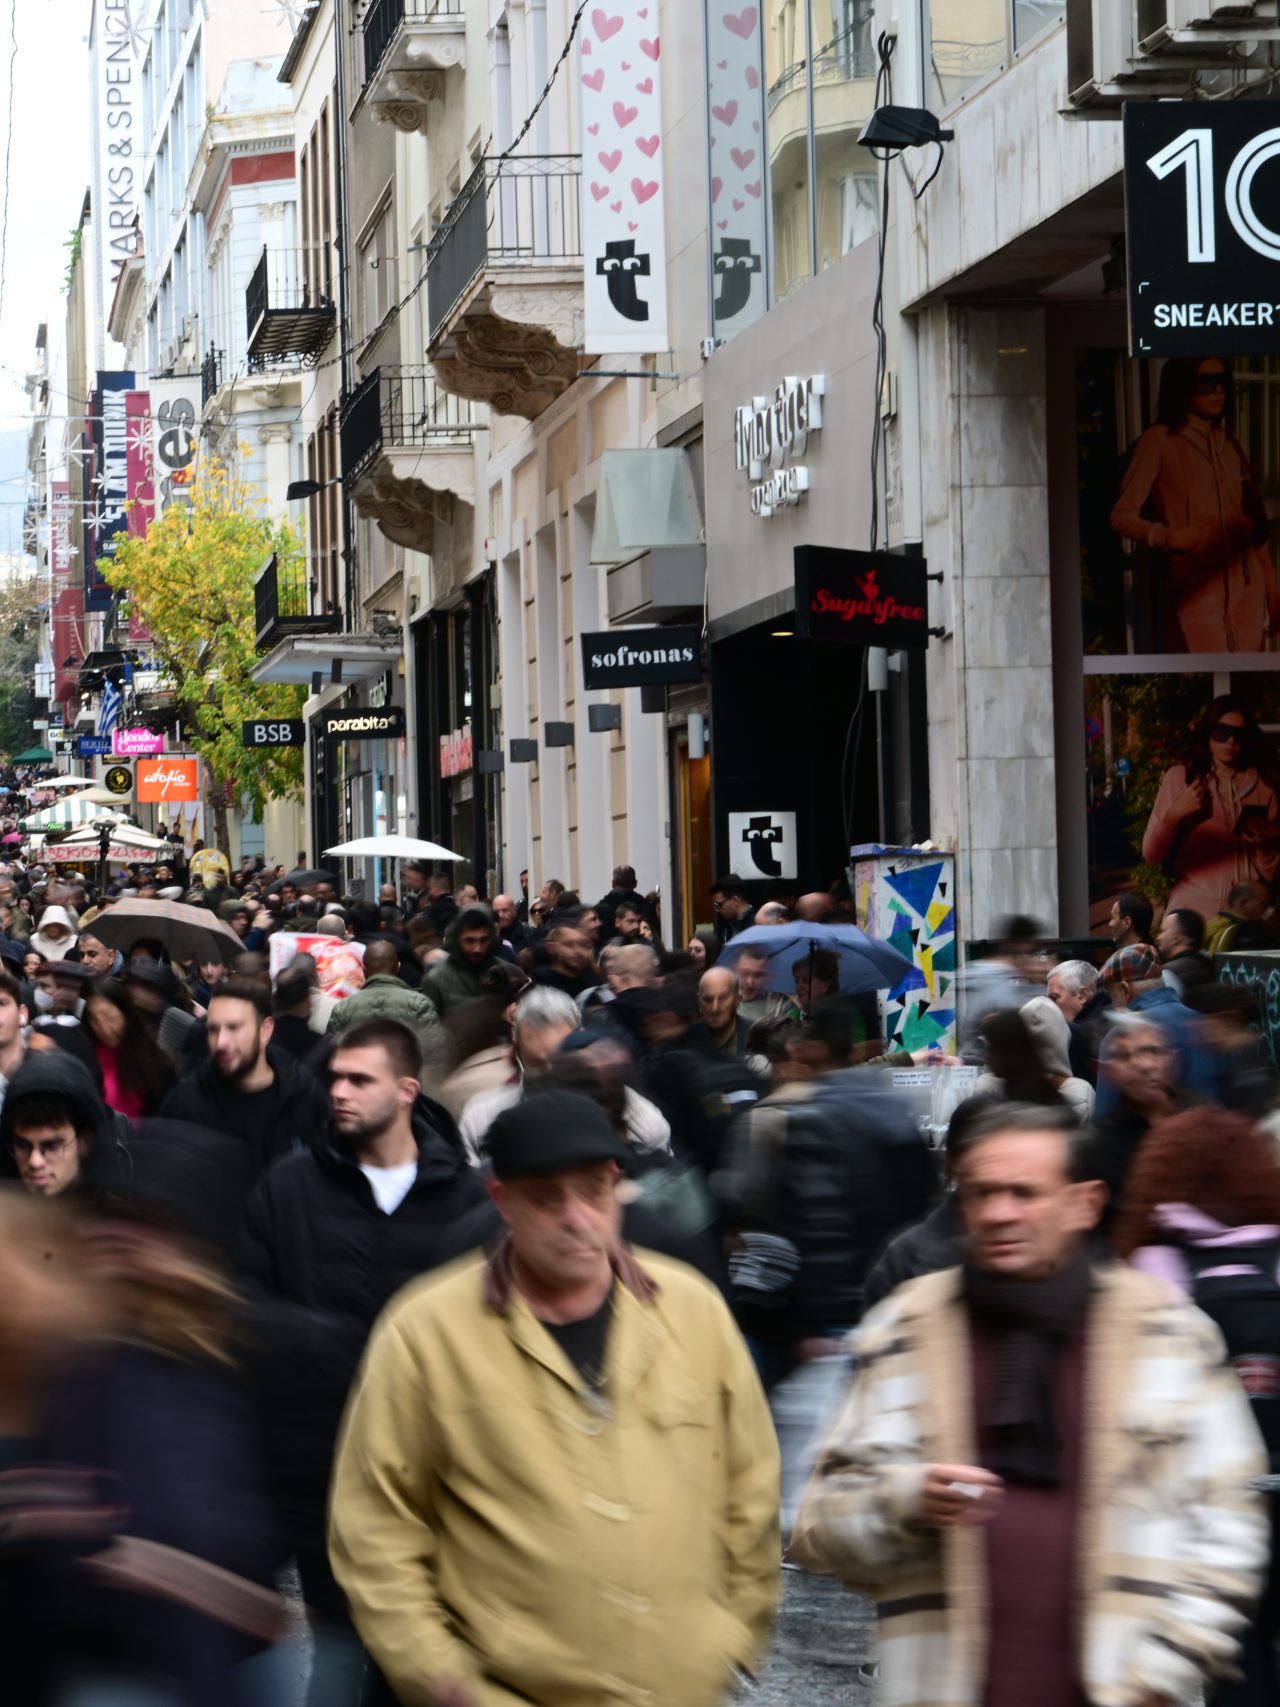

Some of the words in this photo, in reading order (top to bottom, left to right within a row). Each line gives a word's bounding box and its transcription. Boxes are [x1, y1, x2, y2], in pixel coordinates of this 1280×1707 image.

[108, 137, 132, 157] &
[1153, 302, 1280, 328] SNEAKER
[811, 588, 925, 624] Sugarfree
[591, 645, 694, 669] sofronas
[254, 724, 292, 743] BSB
[118, 740, 156, 753] Center
